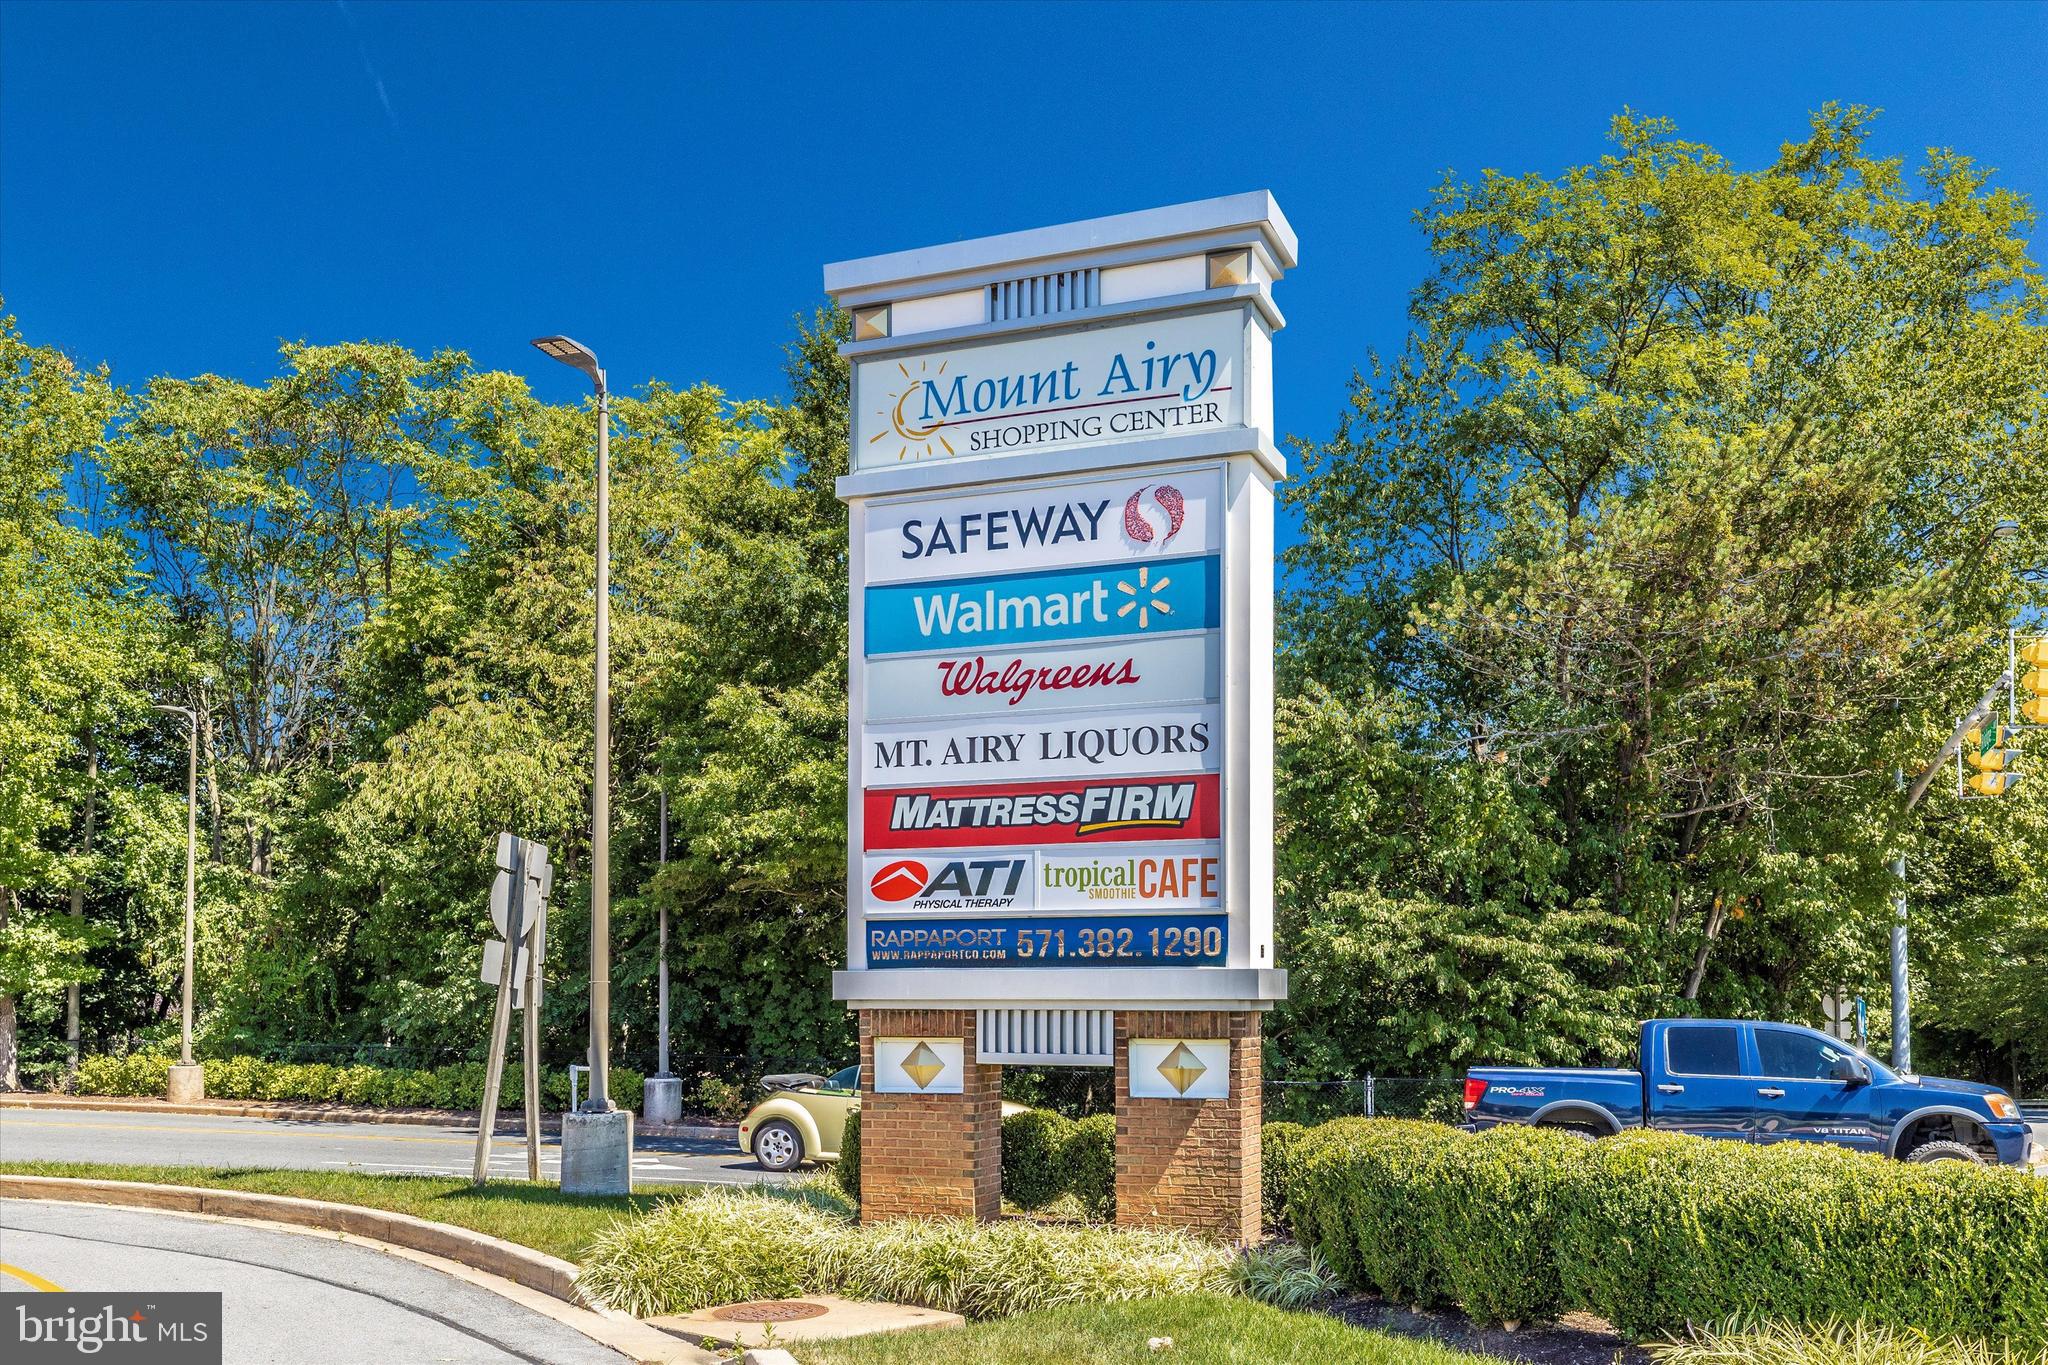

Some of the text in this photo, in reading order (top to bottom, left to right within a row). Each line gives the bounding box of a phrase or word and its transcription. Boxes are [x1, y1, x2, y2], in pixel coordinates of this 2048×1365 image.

[919, 340, 1217, 421] Mount Airy
[970, 403, 1223, 452] SHOPPING CENTER
[901, 499, 1111, 560] SAFEWAY
[913, 580, 1109, 637] Walmart
[937, 656, 1141, 706] Walgreens
[874, 722, 1209, 770] MT. AIRY LIQUORS
[919, 859, 1026, 898] ATI
[1043, 858, 1218, 899] tropical CAFE
[1088, 888, 1136, 900] SMOOTHIE
[913, 898, 1014, 910] PHYSICAL THERAPY
[871, 929, 1006, 947] RAPPAPORT
[1831, 1127, 1866, 1135] TITAN
